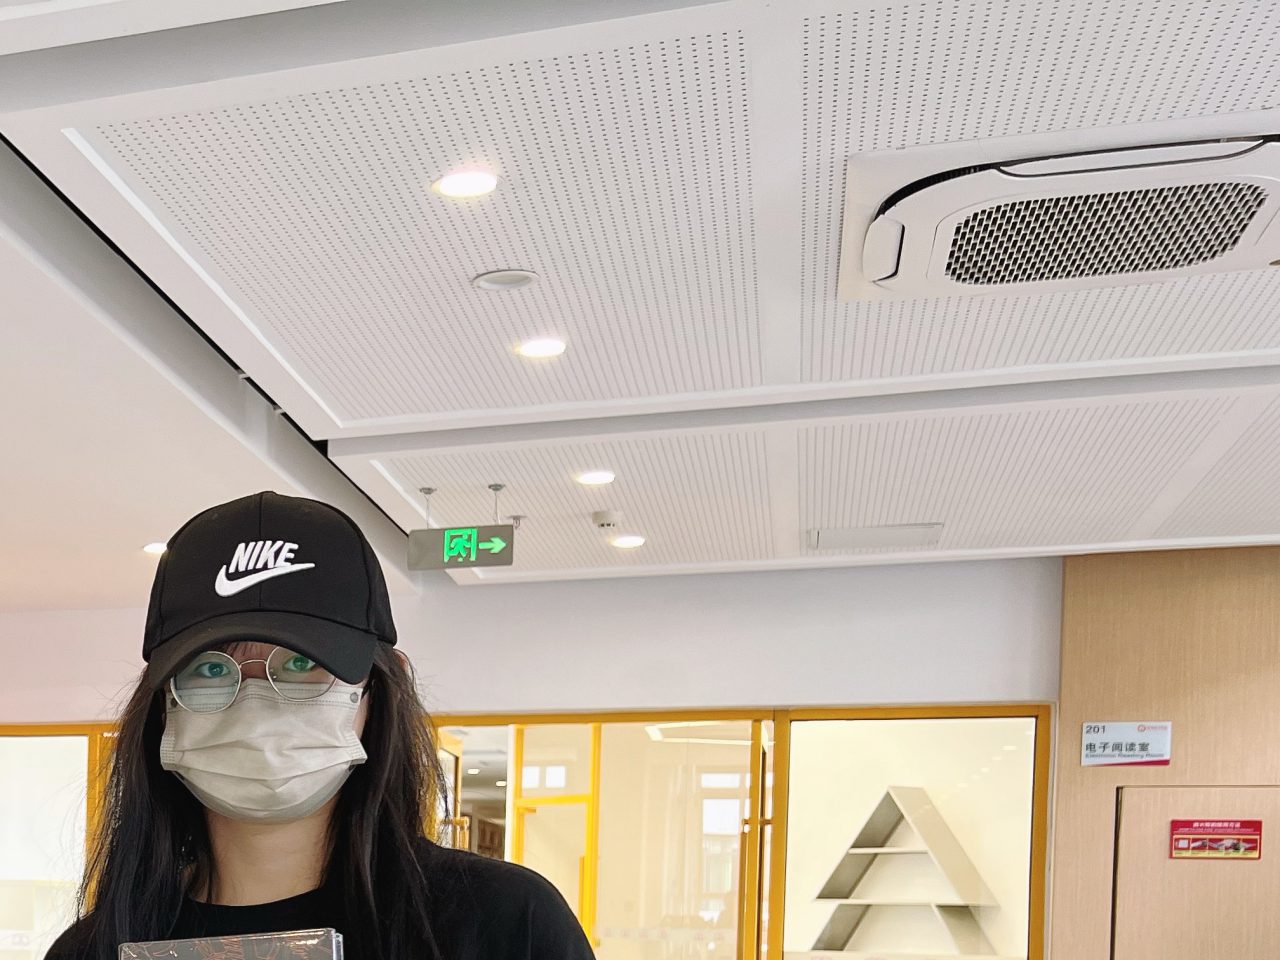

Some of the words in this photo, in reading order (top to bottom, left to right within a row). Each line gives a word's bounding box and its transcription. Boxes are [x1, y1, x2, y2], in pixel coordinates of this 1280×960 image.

[228, 540, 299, 573] NIKE
[1086, 725, 1106, 734] 201
[1085, 742, 1150, 753] 电子阅读室
